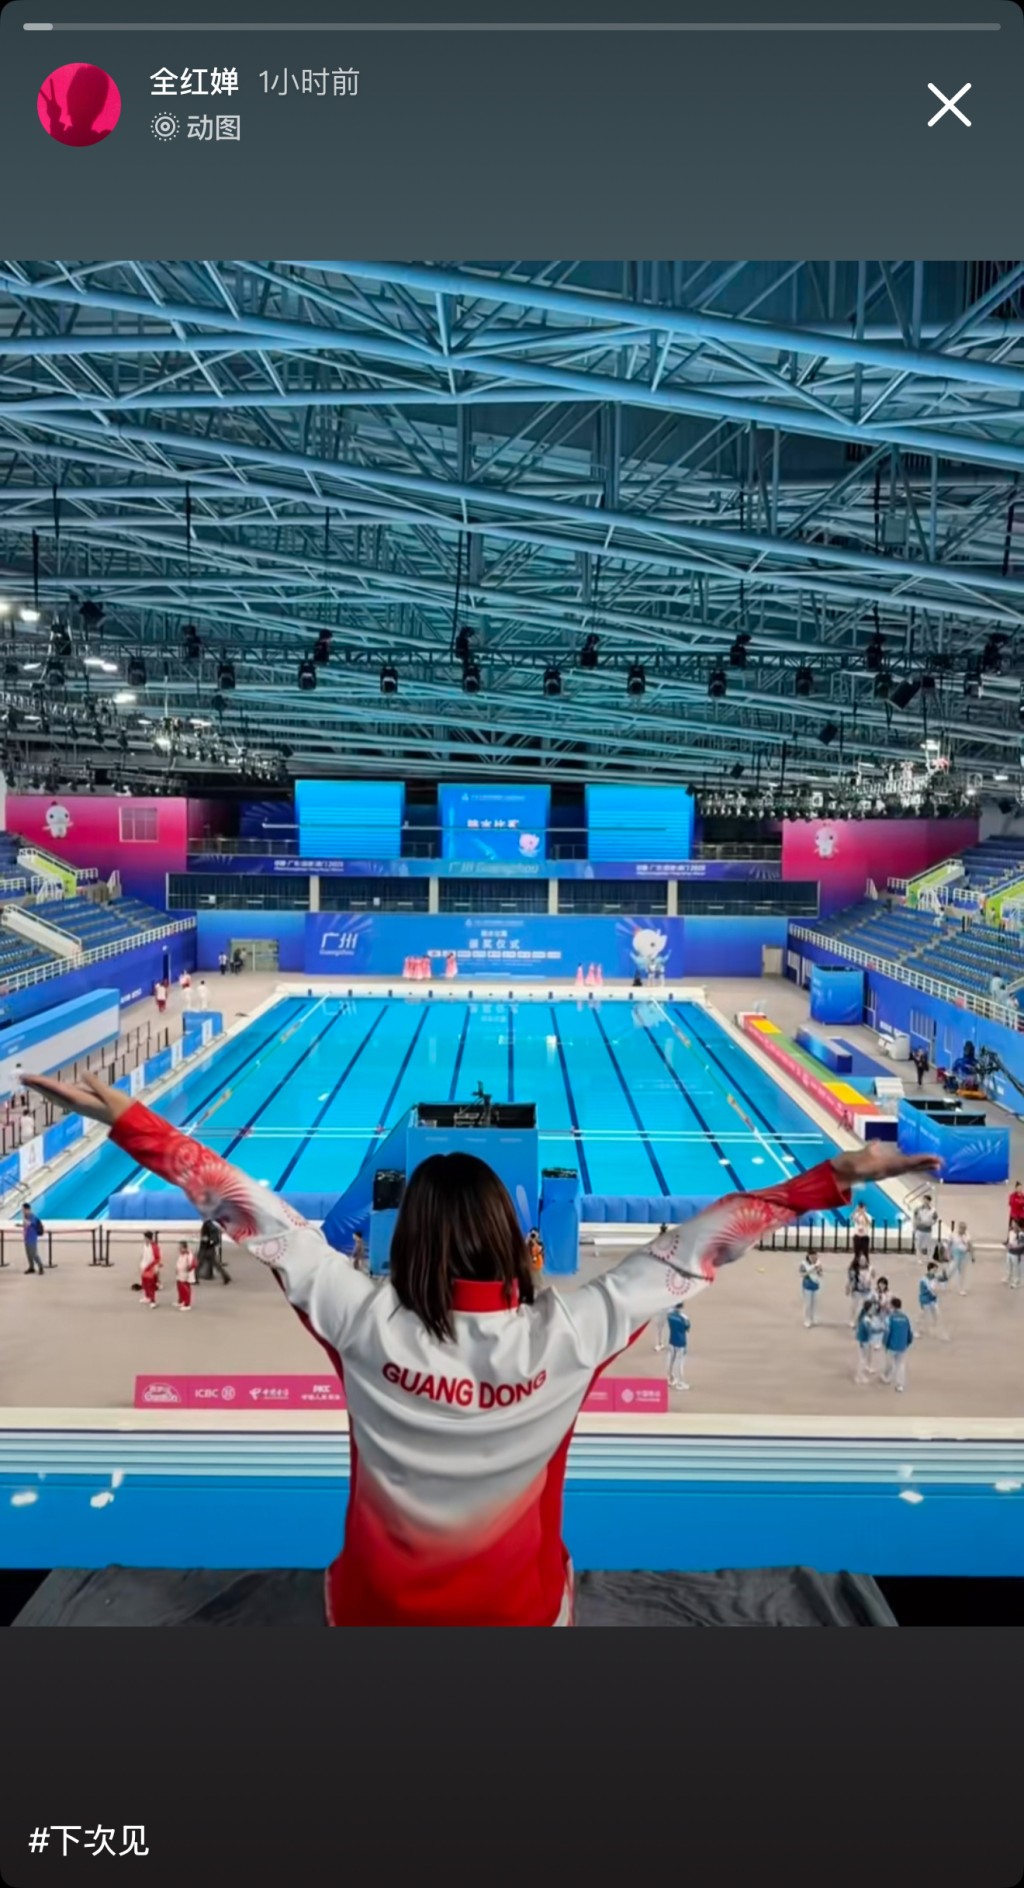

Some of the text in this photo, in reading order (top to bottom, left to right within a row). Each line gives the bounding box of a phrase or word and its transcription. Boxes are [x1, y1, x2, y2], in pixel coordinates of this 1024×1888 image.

[320, 932, 358, 949] 广州
[195, 1388, 219, 1398] ICBC
[382, 1361, 547, 1409] GUANG DONG
